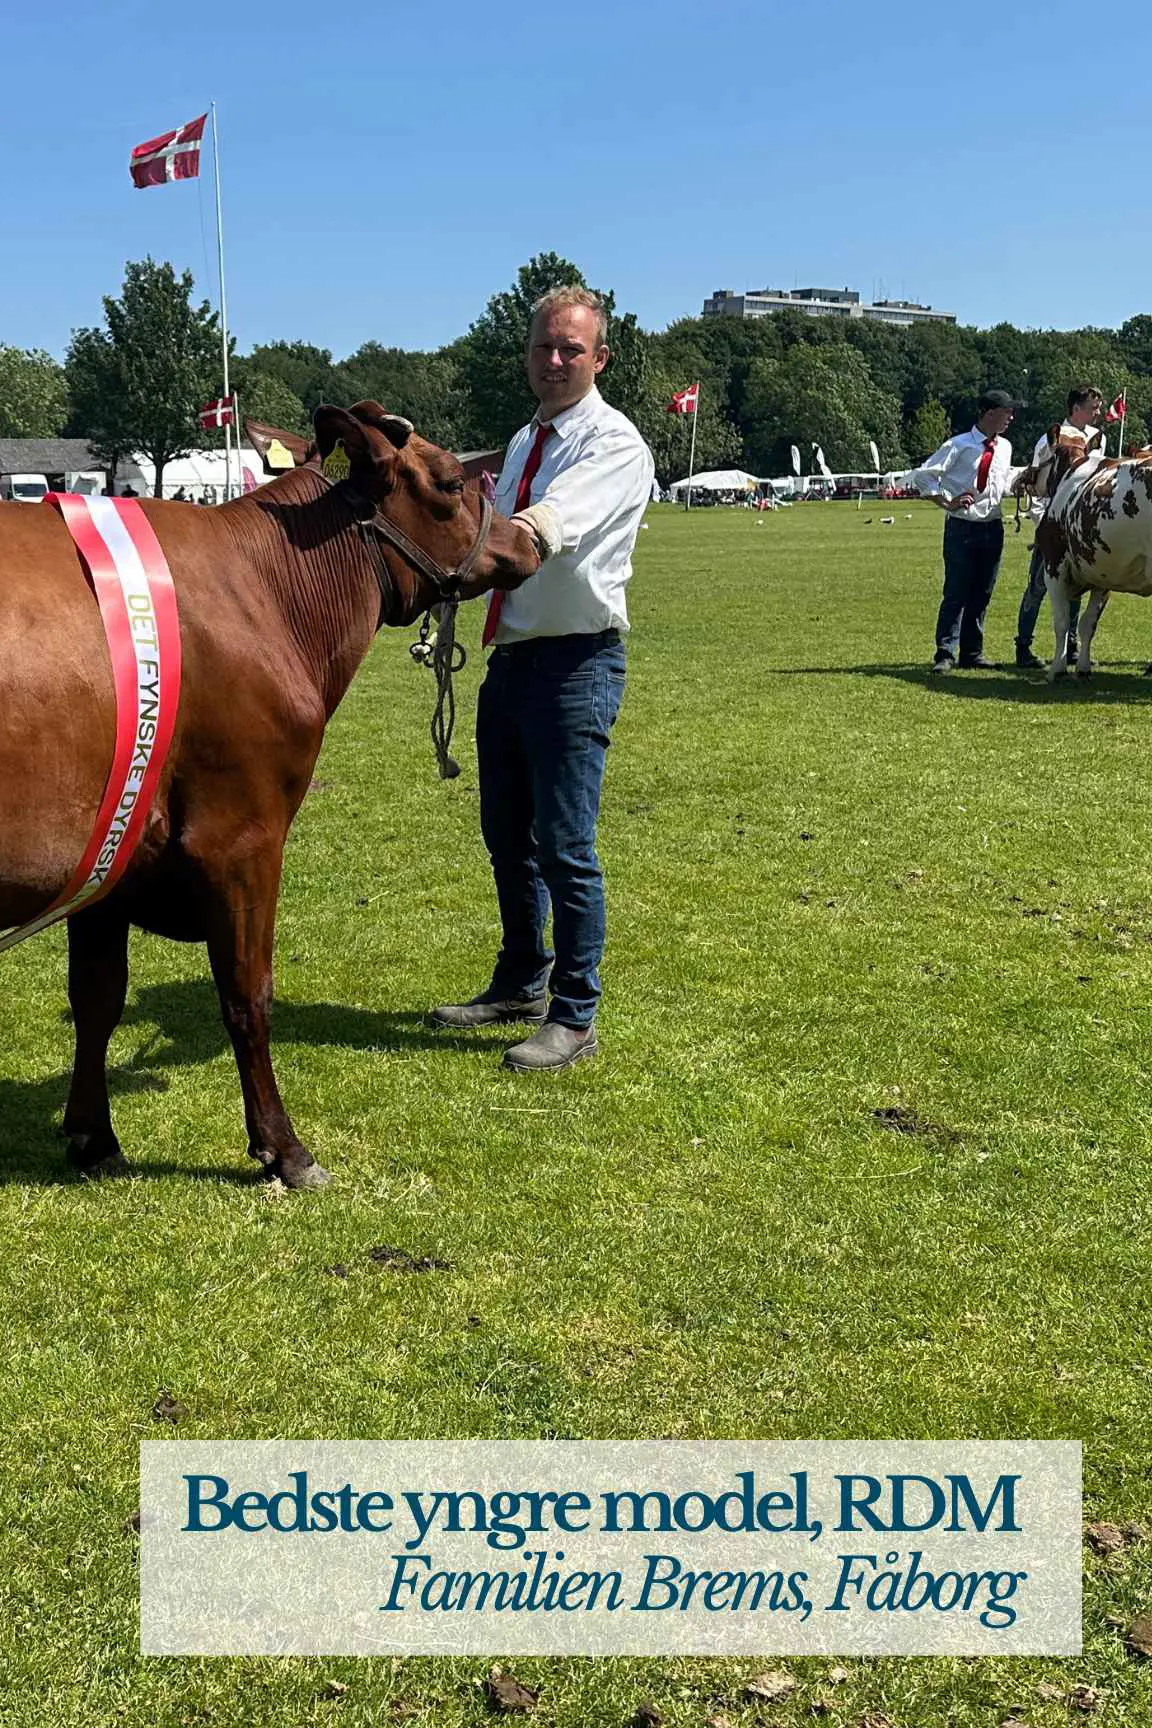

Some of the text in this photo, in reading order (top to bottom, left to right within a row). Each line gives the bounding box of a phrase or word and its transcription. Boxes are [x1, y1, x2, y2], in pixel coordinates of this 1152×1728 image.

[88, 594, 159, 883] DET FYNSKE DYRSK
